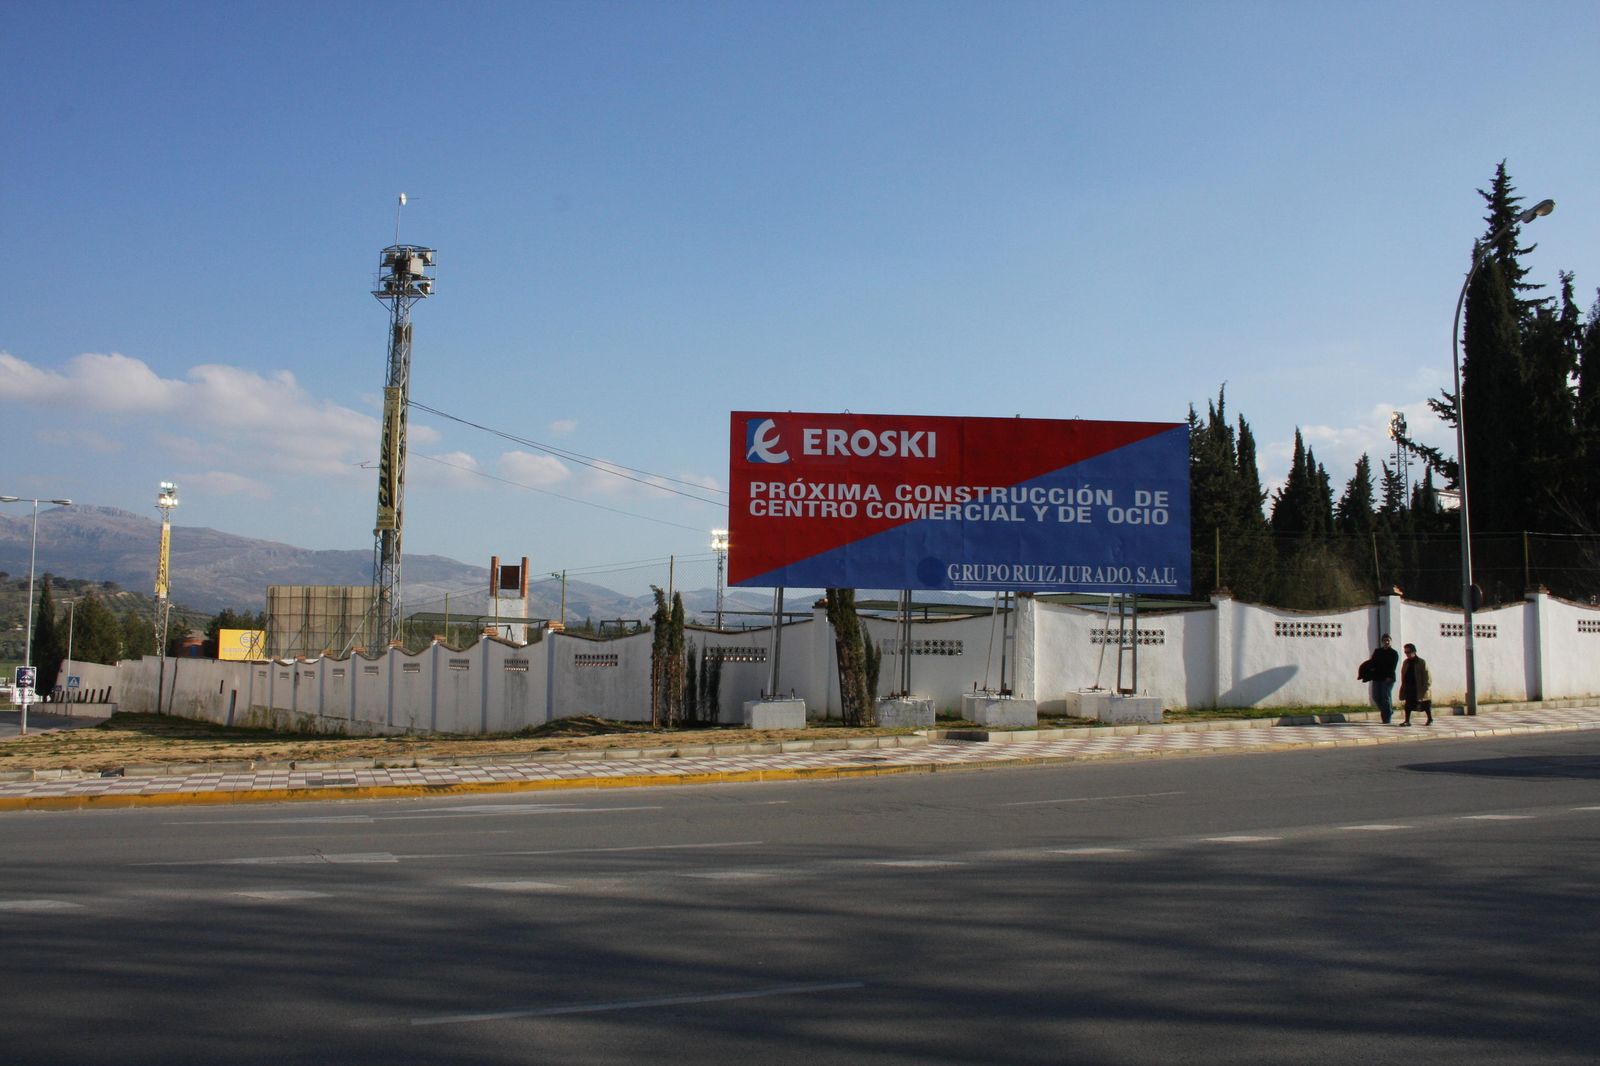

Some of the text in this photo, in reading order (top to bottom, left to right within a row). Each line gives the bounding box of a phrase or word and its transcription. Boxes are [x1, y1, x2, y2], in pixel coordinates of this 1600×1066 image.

[803, 428, 936, 458] EROSKI
[750, 477, 1169, 507] PRÓXIMA CONSTRUCCIÓN DE
[749, 500, 1169, 525] CENTRO COMERCIAL Y DE OCIO
[947, 563, 1010, 583] GRUPO
[1012, 564, 1057, 583] RUIZ
[1136, 566, 1178, 585] S.A.U.
